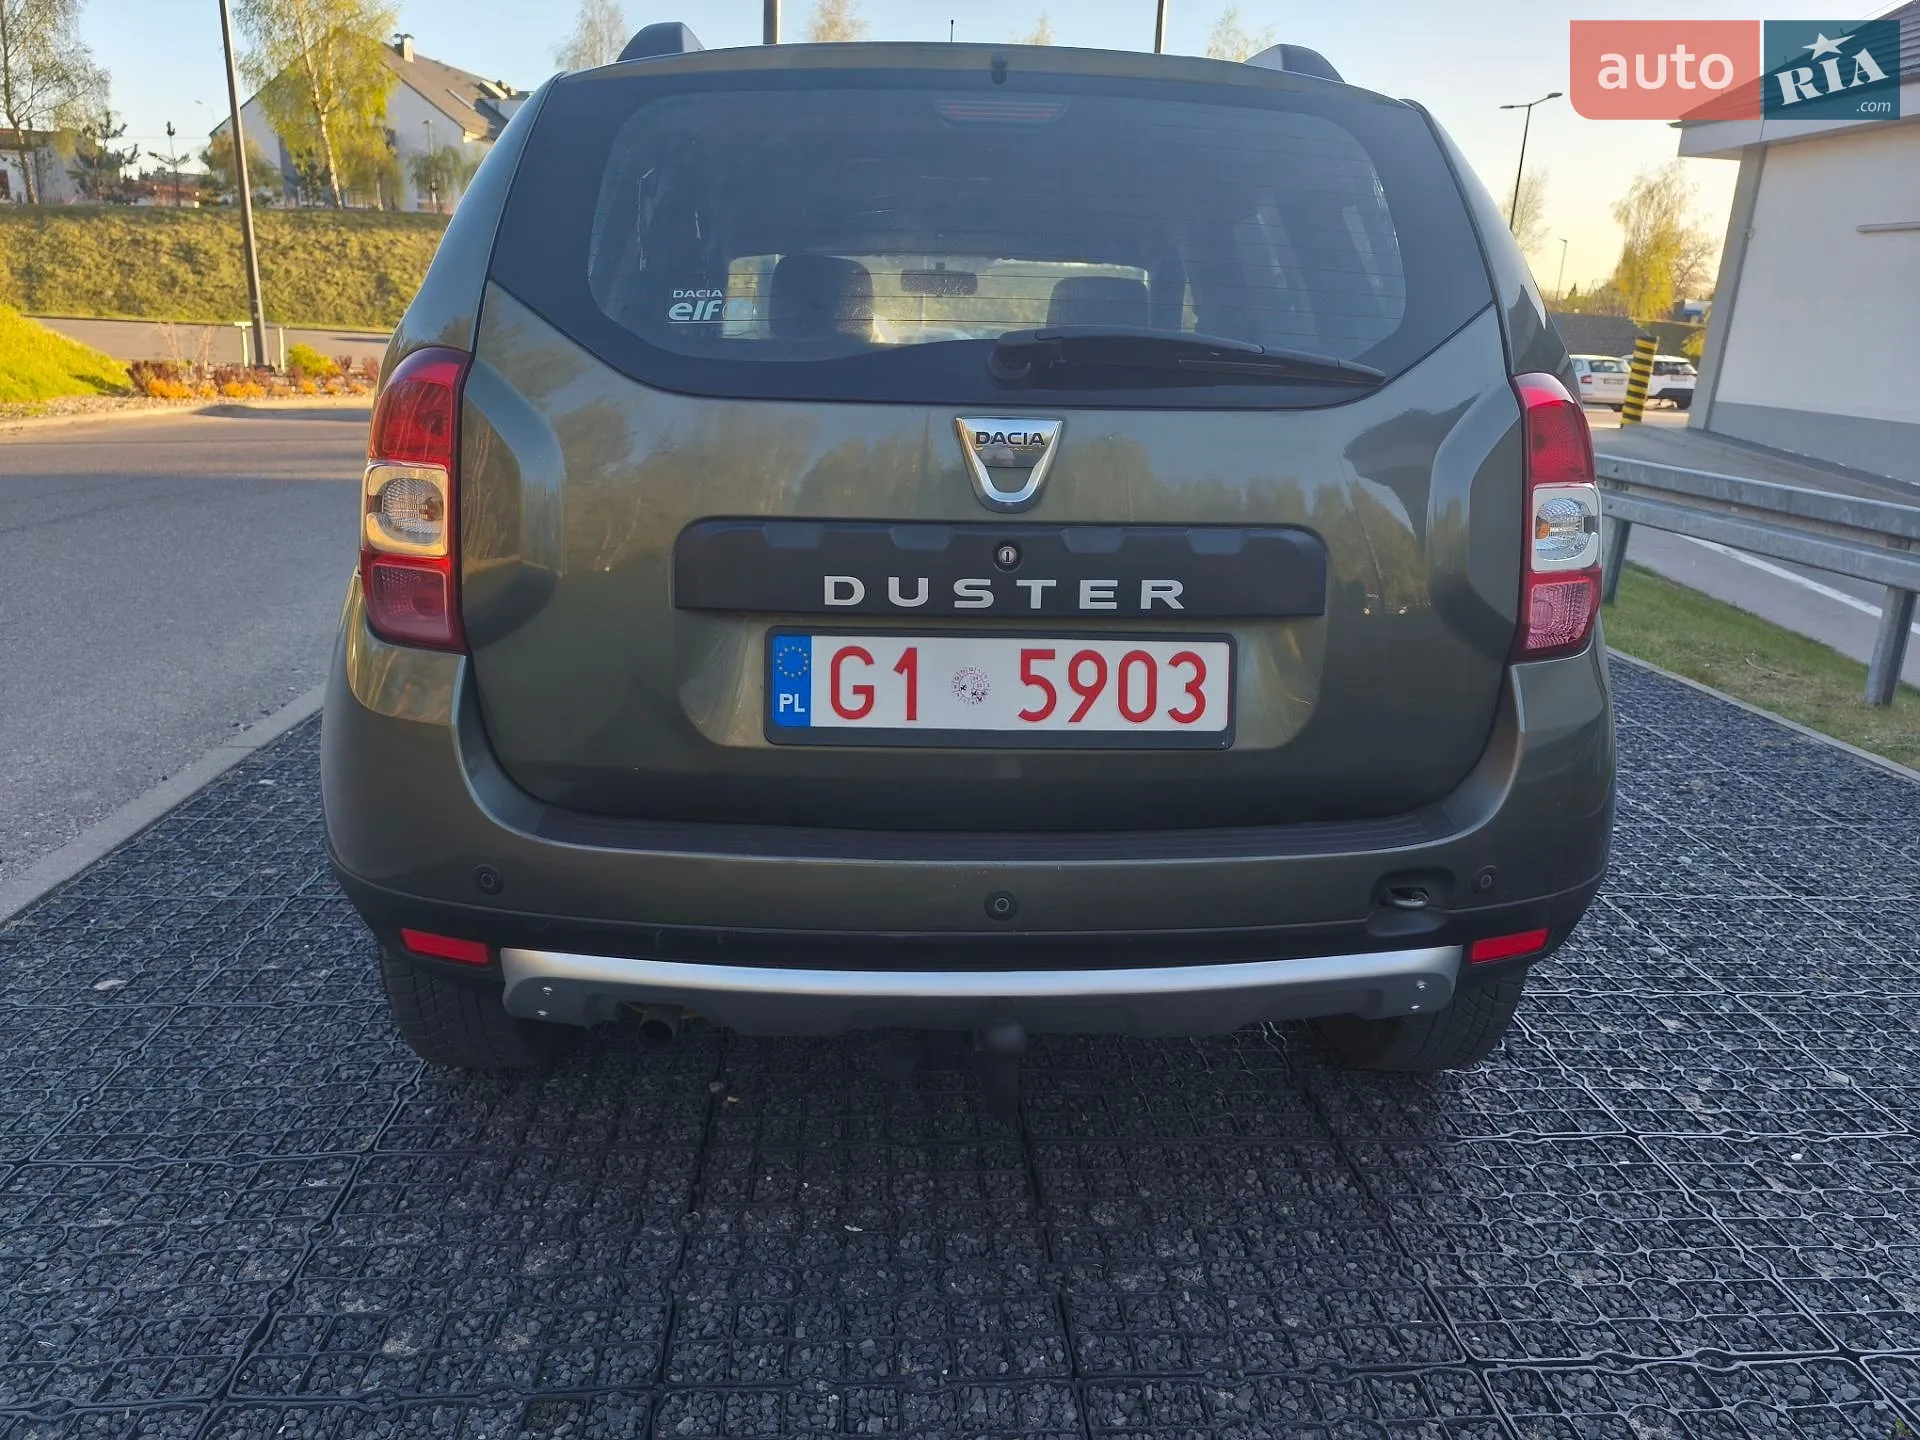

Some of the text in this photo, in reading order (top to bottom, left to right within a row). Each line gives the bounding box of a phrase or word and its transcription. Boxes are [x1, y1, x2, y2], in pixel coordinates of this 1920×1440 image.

[672, 289, 723, 298] DACIA
[668, 300, 722, 321] elf
[975, 431, 1045, 446] DACIA
[823, 575, 1185, 610] DUSTER
[829, 645, 918, 721] G1
[1017, 648, 1207, 724] 5903
[779, 693, 805, 713] PL
